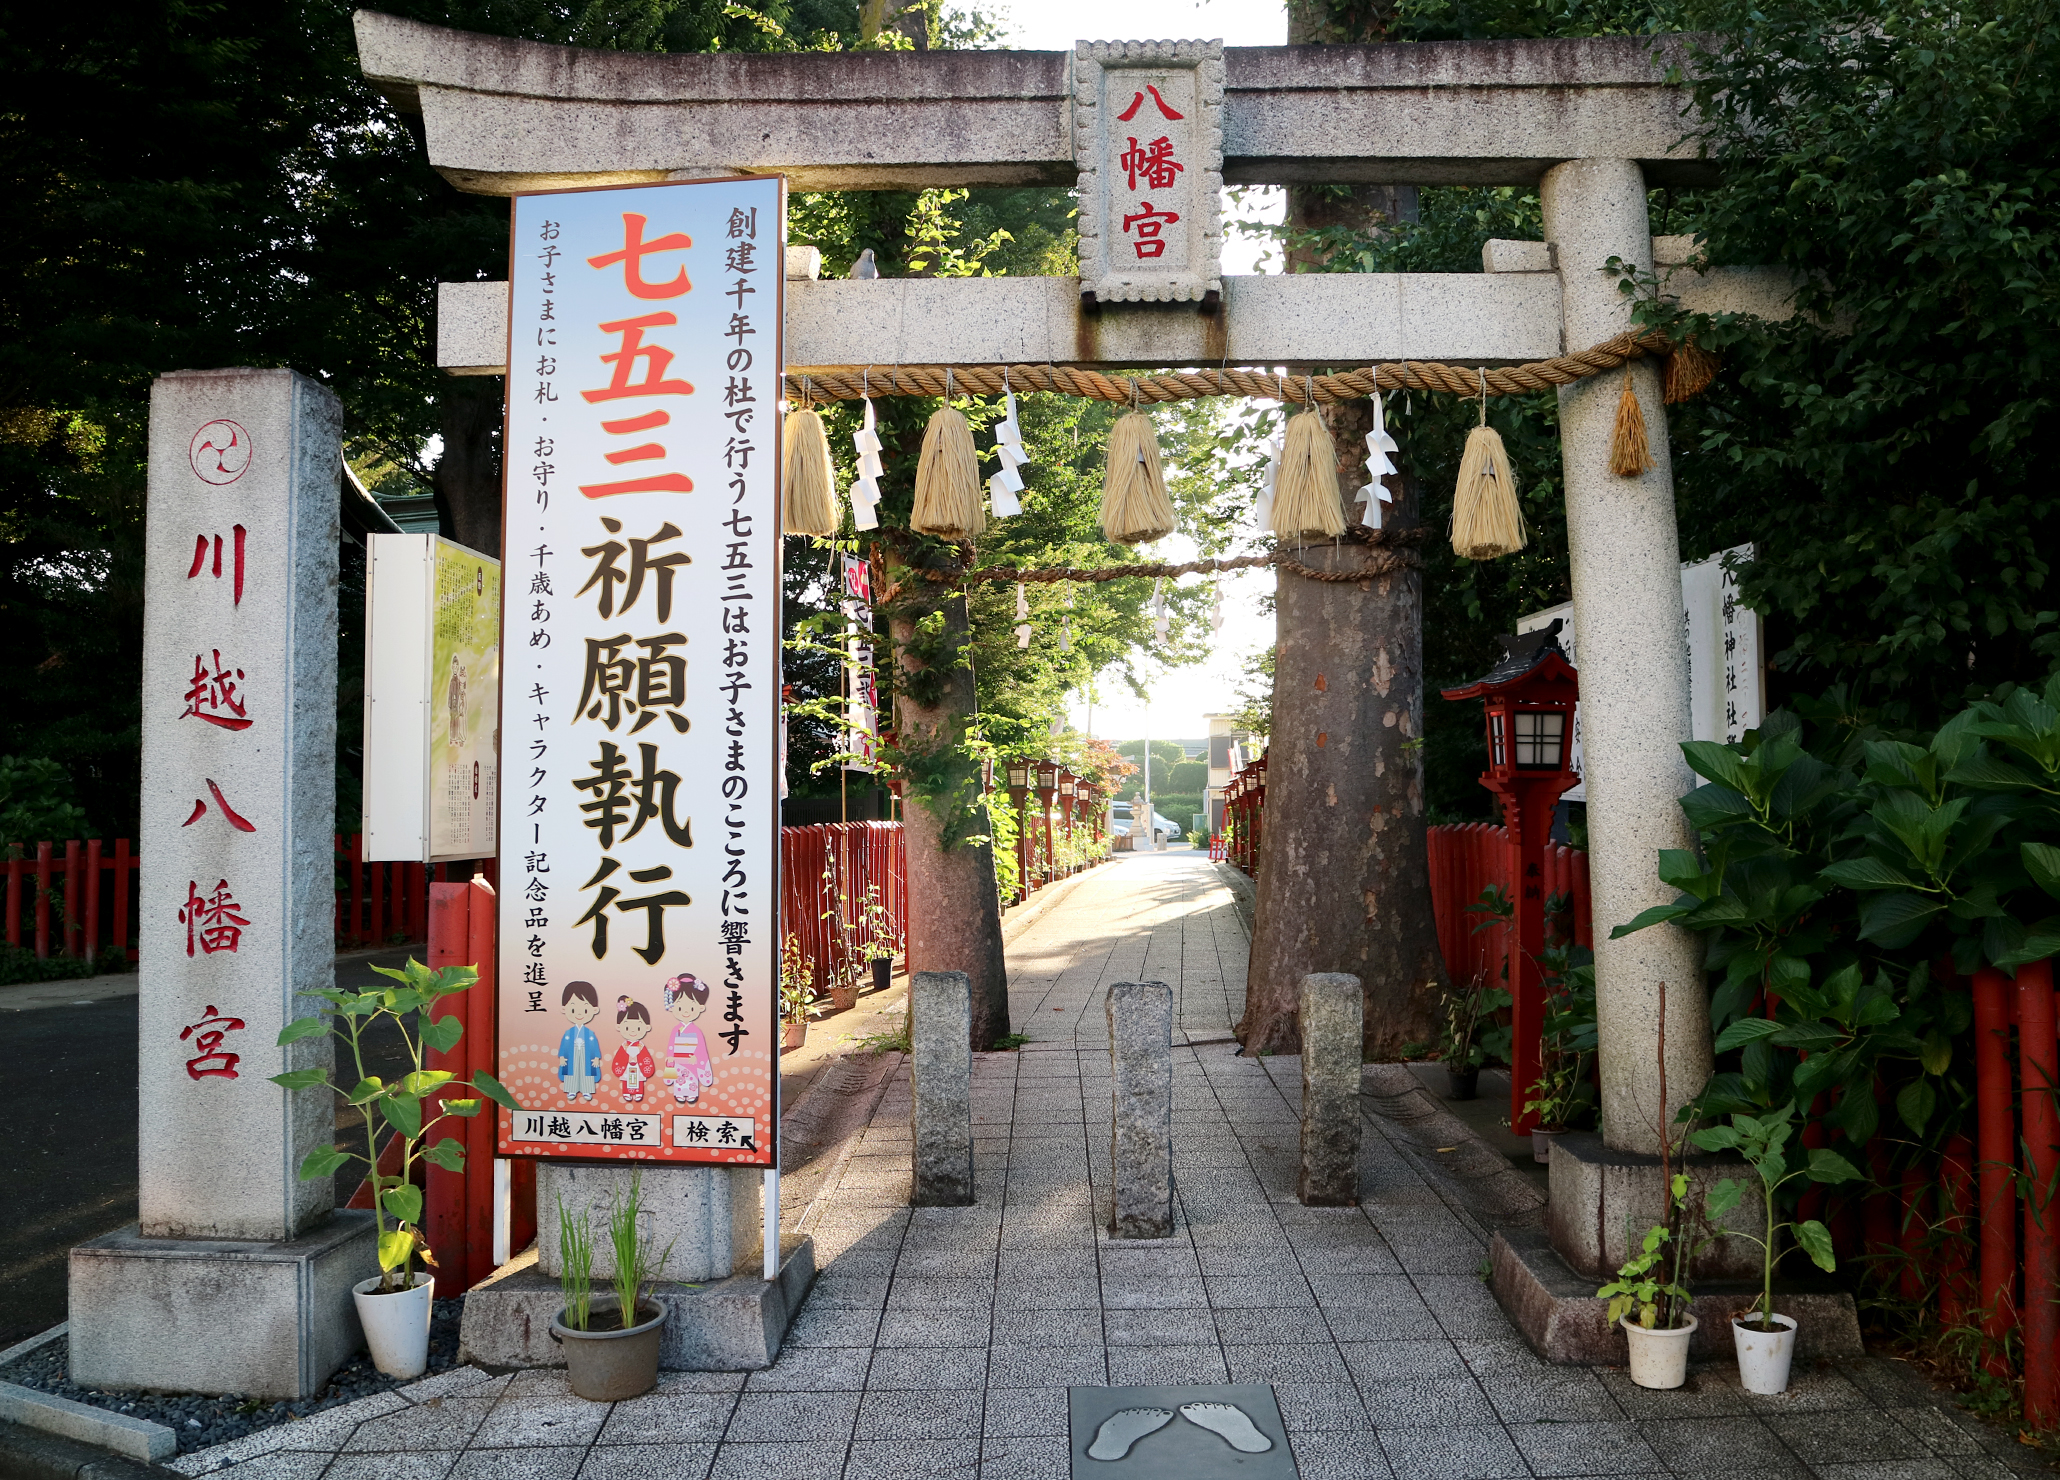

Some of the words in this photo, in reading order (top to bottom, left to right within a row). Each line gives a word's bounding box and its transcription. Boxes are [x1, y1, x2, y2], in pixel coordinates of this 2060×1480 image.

[1117, 84, 1184, 259] 八幡宮
[571, 211, 696, 967] 七五三祈願執行
[717, 206, 759, 1056] 創建千年の杜で行う七五三はお子さまのこころに響きます
[178, 523, 256, 1080] 川越八幡宮
[524, 1117, 649, 1142] 川越八幡宮
[686, 1120, 740, 1145] 検索
